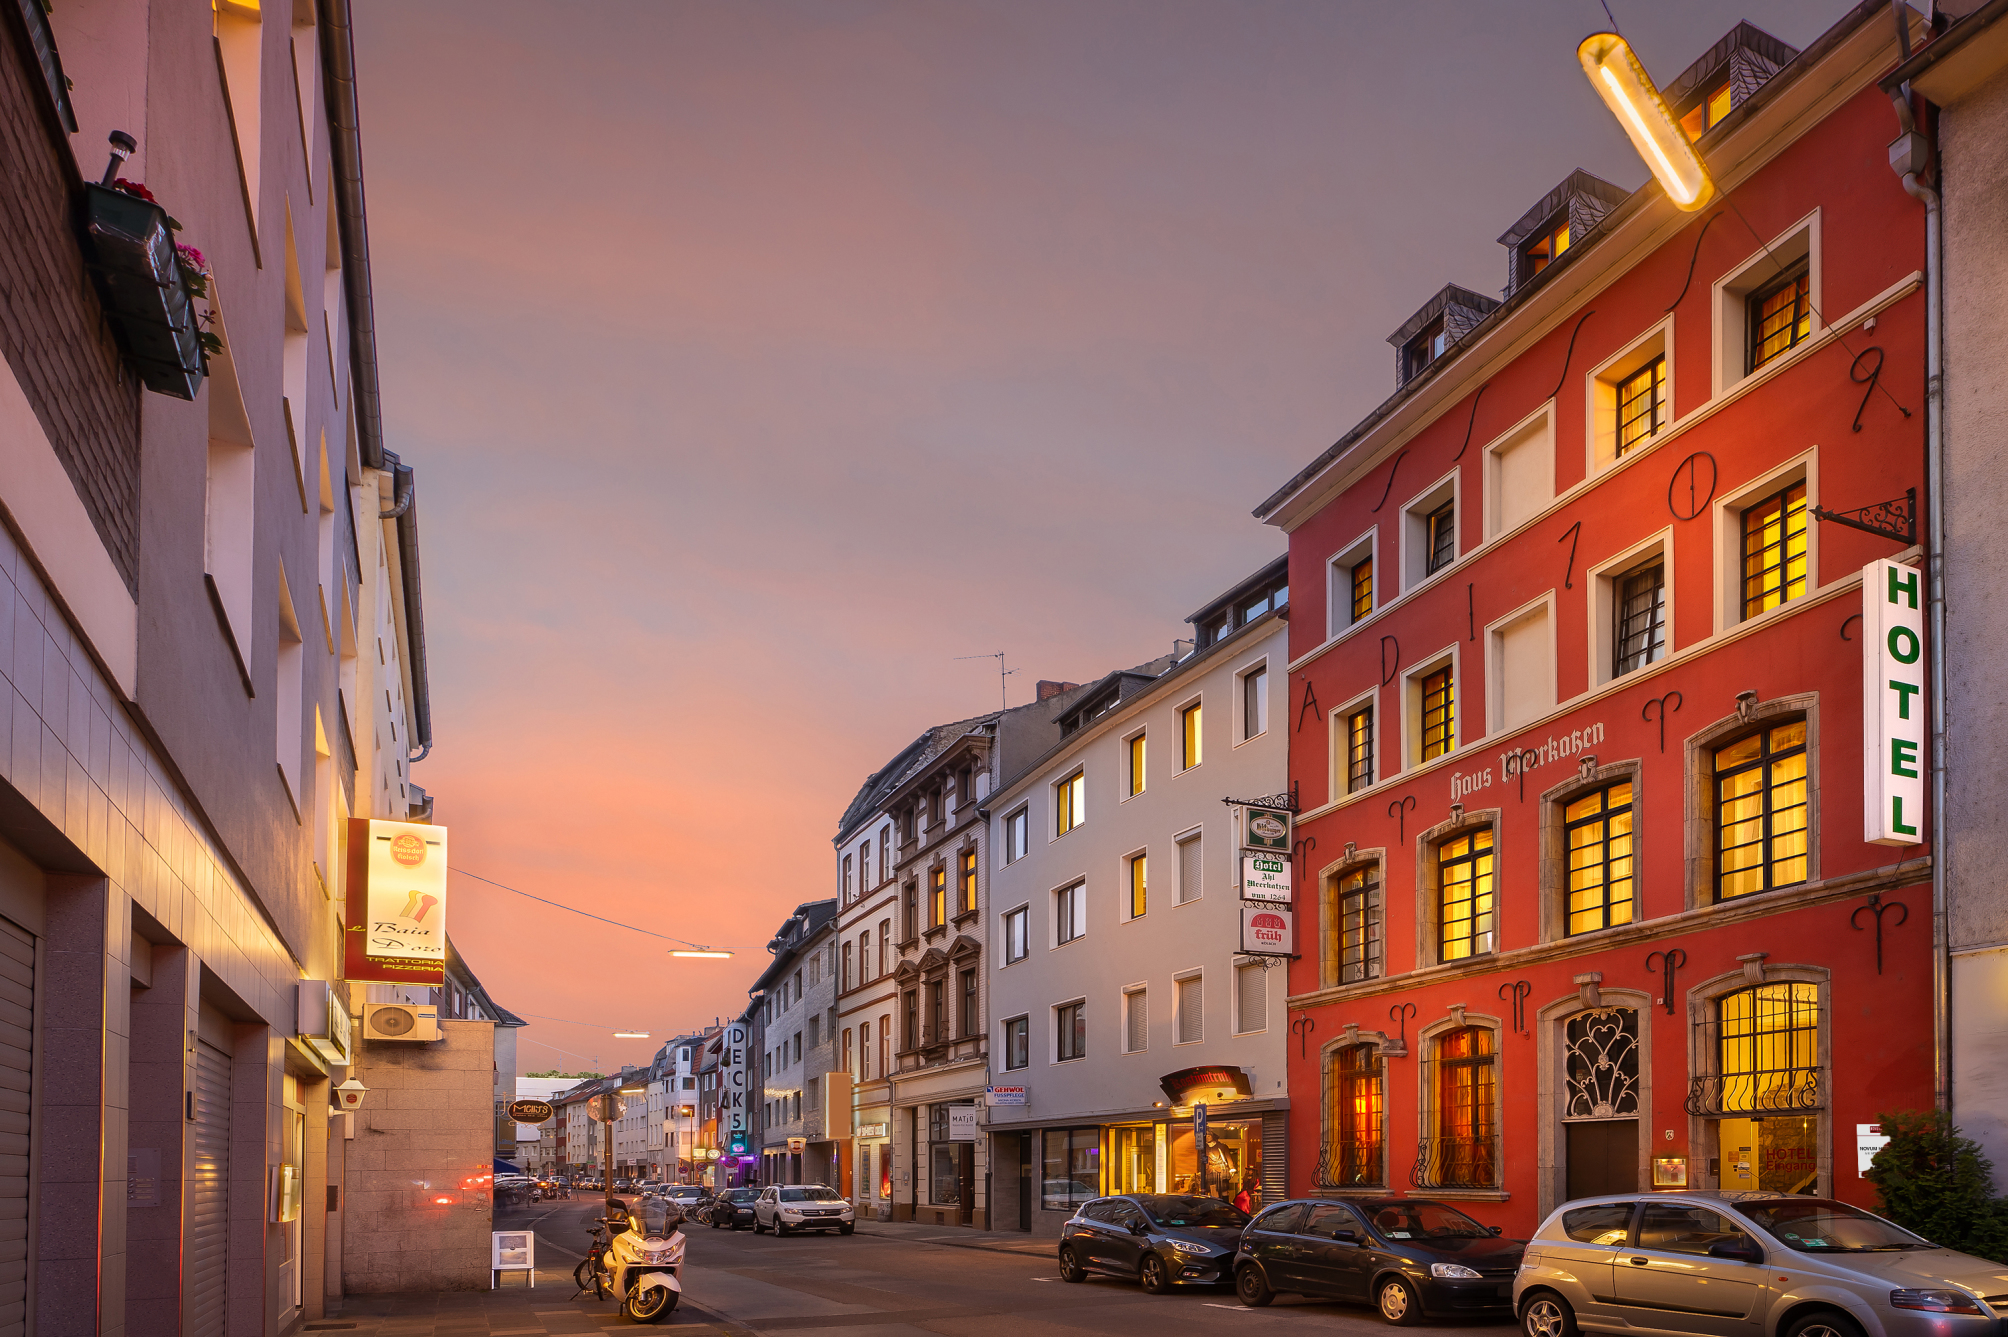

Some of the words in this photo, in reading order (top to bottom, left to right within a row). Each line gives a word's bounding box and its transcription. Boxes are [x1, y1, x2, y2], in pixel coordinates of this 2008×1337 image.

[1887, 565, 1920, 836] HOTEL
[1450, 767, 1492, 803] Haus
[1255, 860, 1282, 871] Hotel
[374, 922, 430, 935] Baia
[1255, 928, 1282, 942] früh
[366, 956, 444, 965] TRATTORIA
[382, 964, 444, 972] PIZZERIA
[1196, 1108, 1204, 1132] P
[1766, 1148, 1816, 1160] HOTEL
[1766, 1160, 1816, 1173] Eingang
